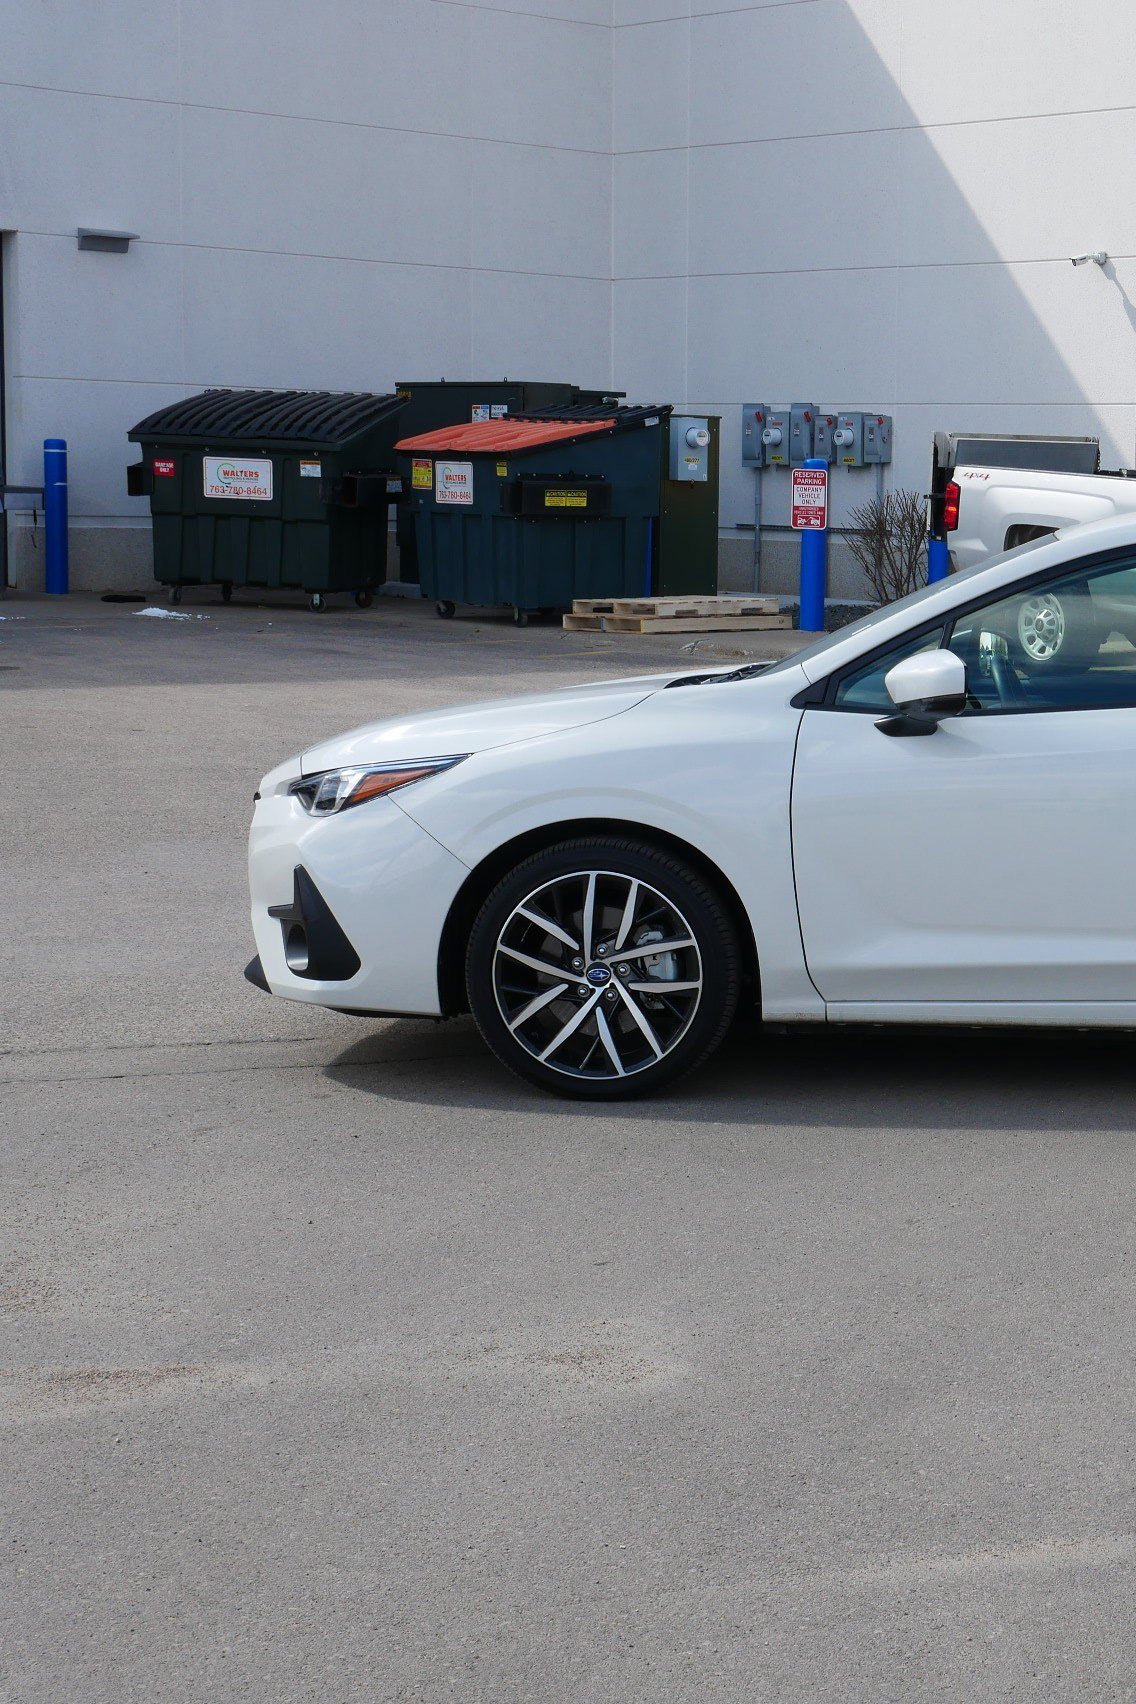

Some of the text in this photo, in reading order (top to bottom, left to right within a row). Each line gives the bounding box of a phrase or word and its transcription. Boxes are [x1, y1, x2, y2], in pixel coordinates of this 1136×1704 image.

[222, 469, 260, 478] WALTERS
[444, 474, 467, 482] WALTERS
[209, 485, 268, 496] 763-780-8464
